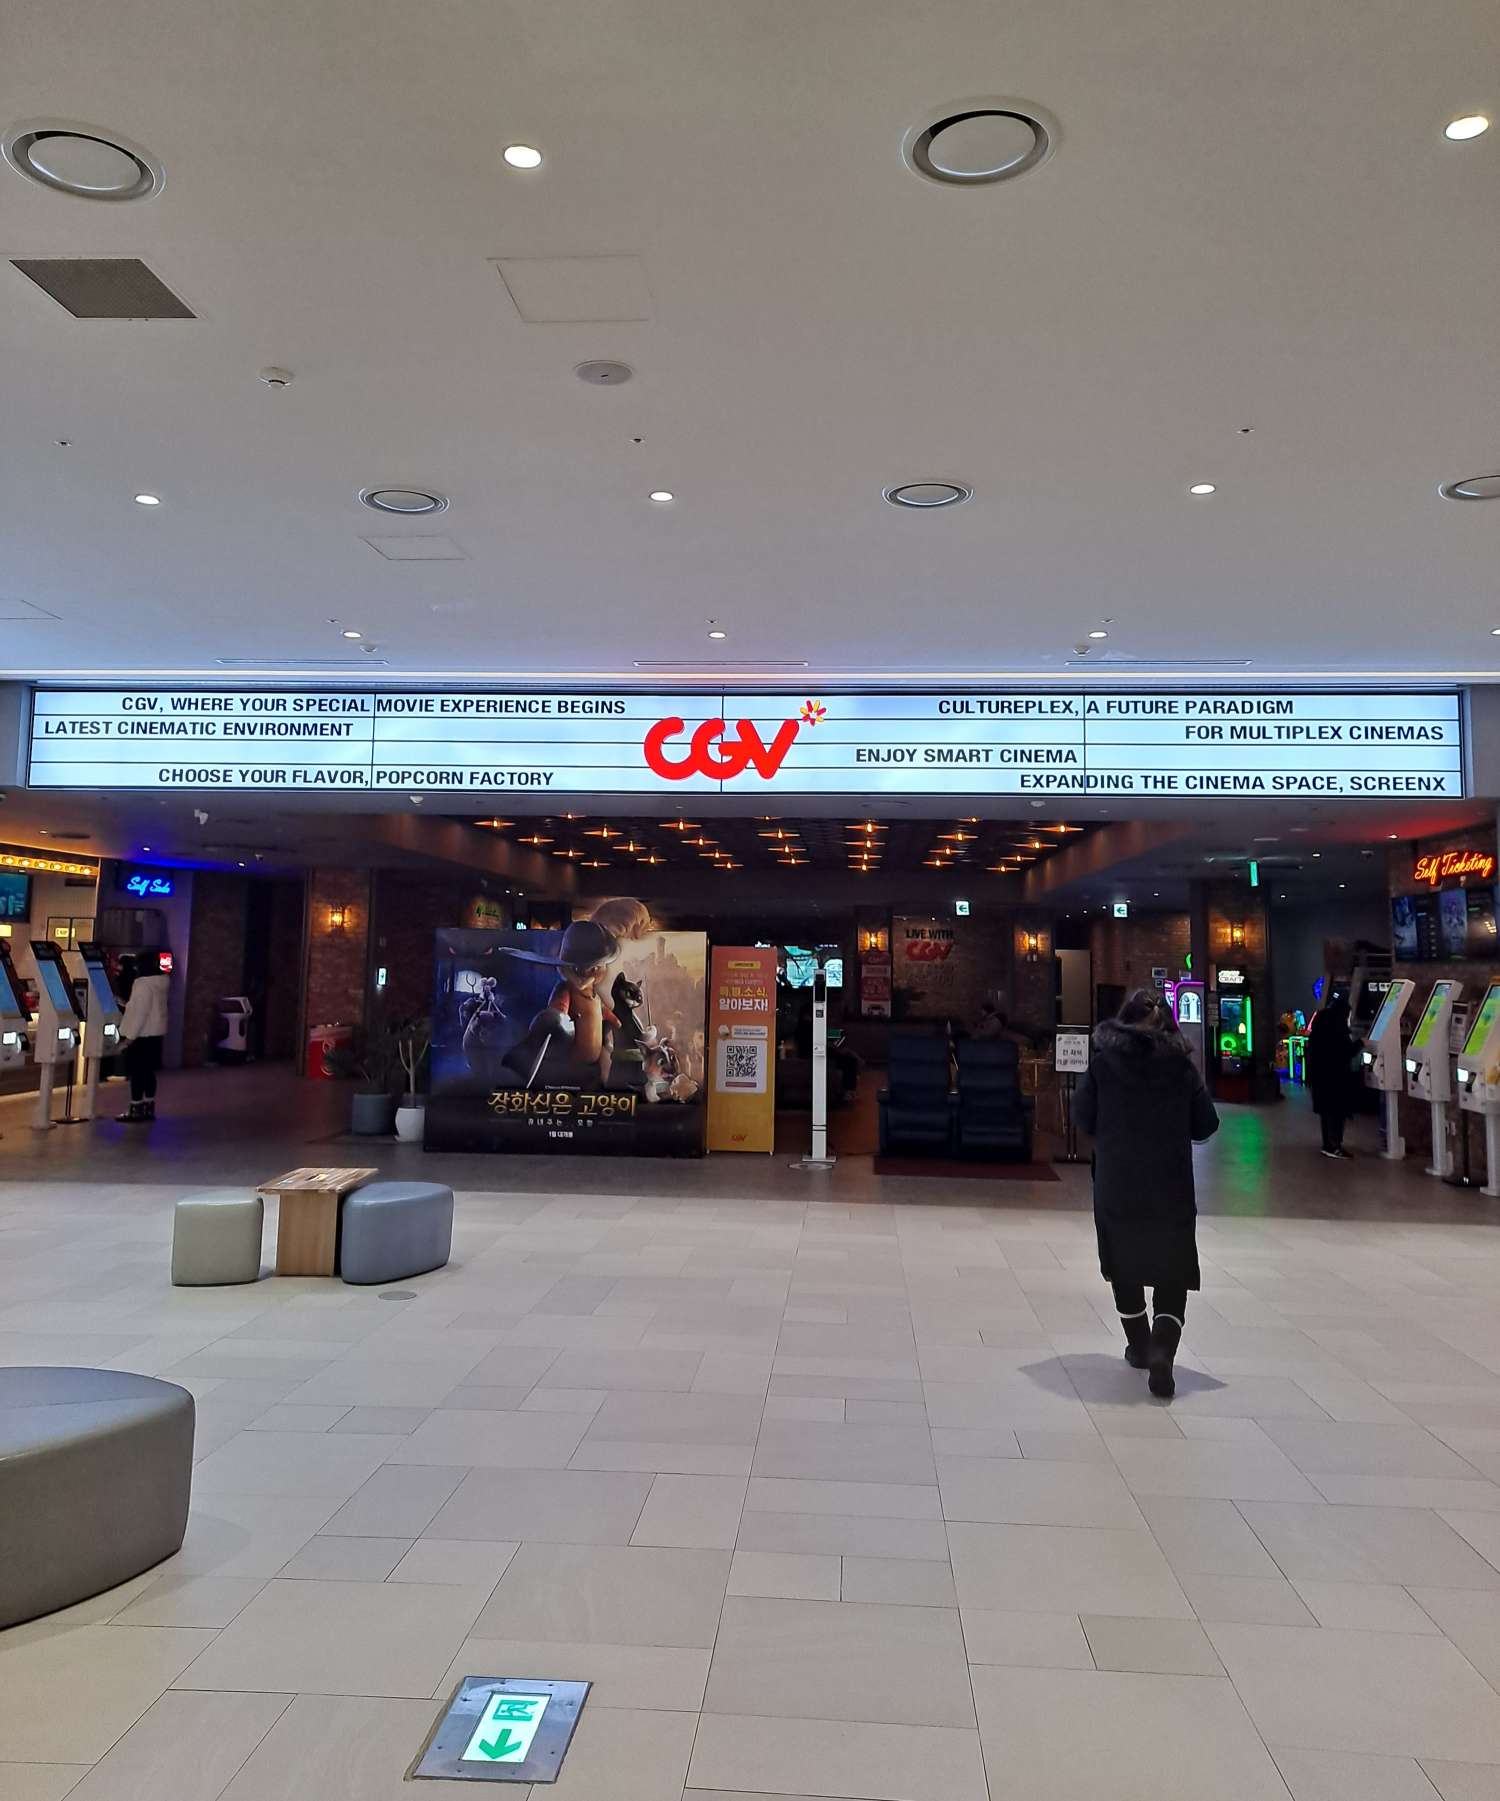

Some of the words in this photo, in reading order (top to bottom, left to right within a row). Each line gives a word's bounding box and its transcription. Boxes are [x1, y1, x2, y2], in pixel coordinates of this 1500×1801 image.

[121, 697, 164, 713] CGV,
[171, 698, 233, 711] WHERE
[240, 698, 286, 711] YOUR
[293, 699, 370, 711] SPECIAL
[377, 699, 434, 712] MOVIE
[441, 700, 551, 713] EXPERIENCE
[558, 701, 625, 713] BEGINS
[939, 701, 1078, 715] CULTUREPLEX,
[1086, 701, 1099, 713] A
[1107, 701, 1178, 714] FUTURE
[1186, 701, 1293, 714] PARADIGM
[44, 721, 112, 735] LATEST
[117, 722, 216, 736] CINEMATIC
[222, 723, 353, 736] ENVIRONMENT
[1186, 726, 1223, 739] FOR
[1231, 726, 1342, 739] MULTIPLEX
[1350, 726, 1443, 740] CINEMAS
[644, 716, 800, 780] CGV
[856, 749, 917, 762] ENJOY
[924, 749, 993, 762] SMART
[1000, 749, 1077, 762] CINEMA
[158, 768, 233, 783] CHOOSE
[239, 770, 286, 783] YOUR
[293, 770, 368, 786] FLAVOR,
[377, 771, 463, 784] POPCORN
[470, 772, 553, 785] FACTORY
[1021, 774, 1134, 789] EXPANDING
[1141, 776, 1178, 789] THE
[1186, 776, 1265, 789] CINEMA
[1272, 776, 1343, 792] SPACE,
[1351, 777, 1445, 790] SCREENX
[1414, 857, 1441, 885] Self
[1441, 852, 1493, 878] Ticketing
[906, 929, 927, 939] LIVE
[719, 998, 768, 1011] 알아보자!
[488, 1092, 573, 1115] 장화신은
[577, 1095, 637, 1117] 고양이
